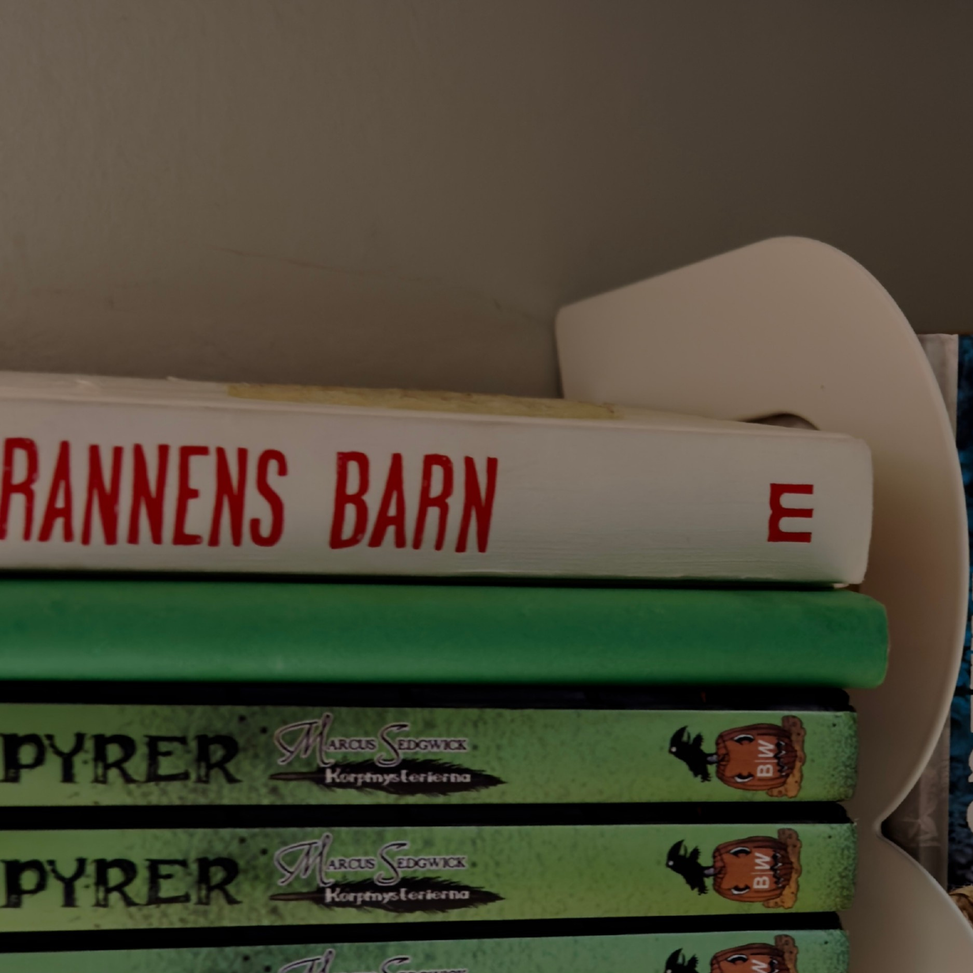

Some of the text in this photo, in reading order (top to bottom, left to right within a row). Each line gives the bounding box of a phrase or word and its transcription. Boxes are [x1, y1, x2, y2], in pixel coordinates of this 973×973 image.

[0, 438, 498, 552] RANNENS BARN
[325, 768, 471, 788] Korpmysterierna
[325, 886, 470, 903] Korpmysterierna
